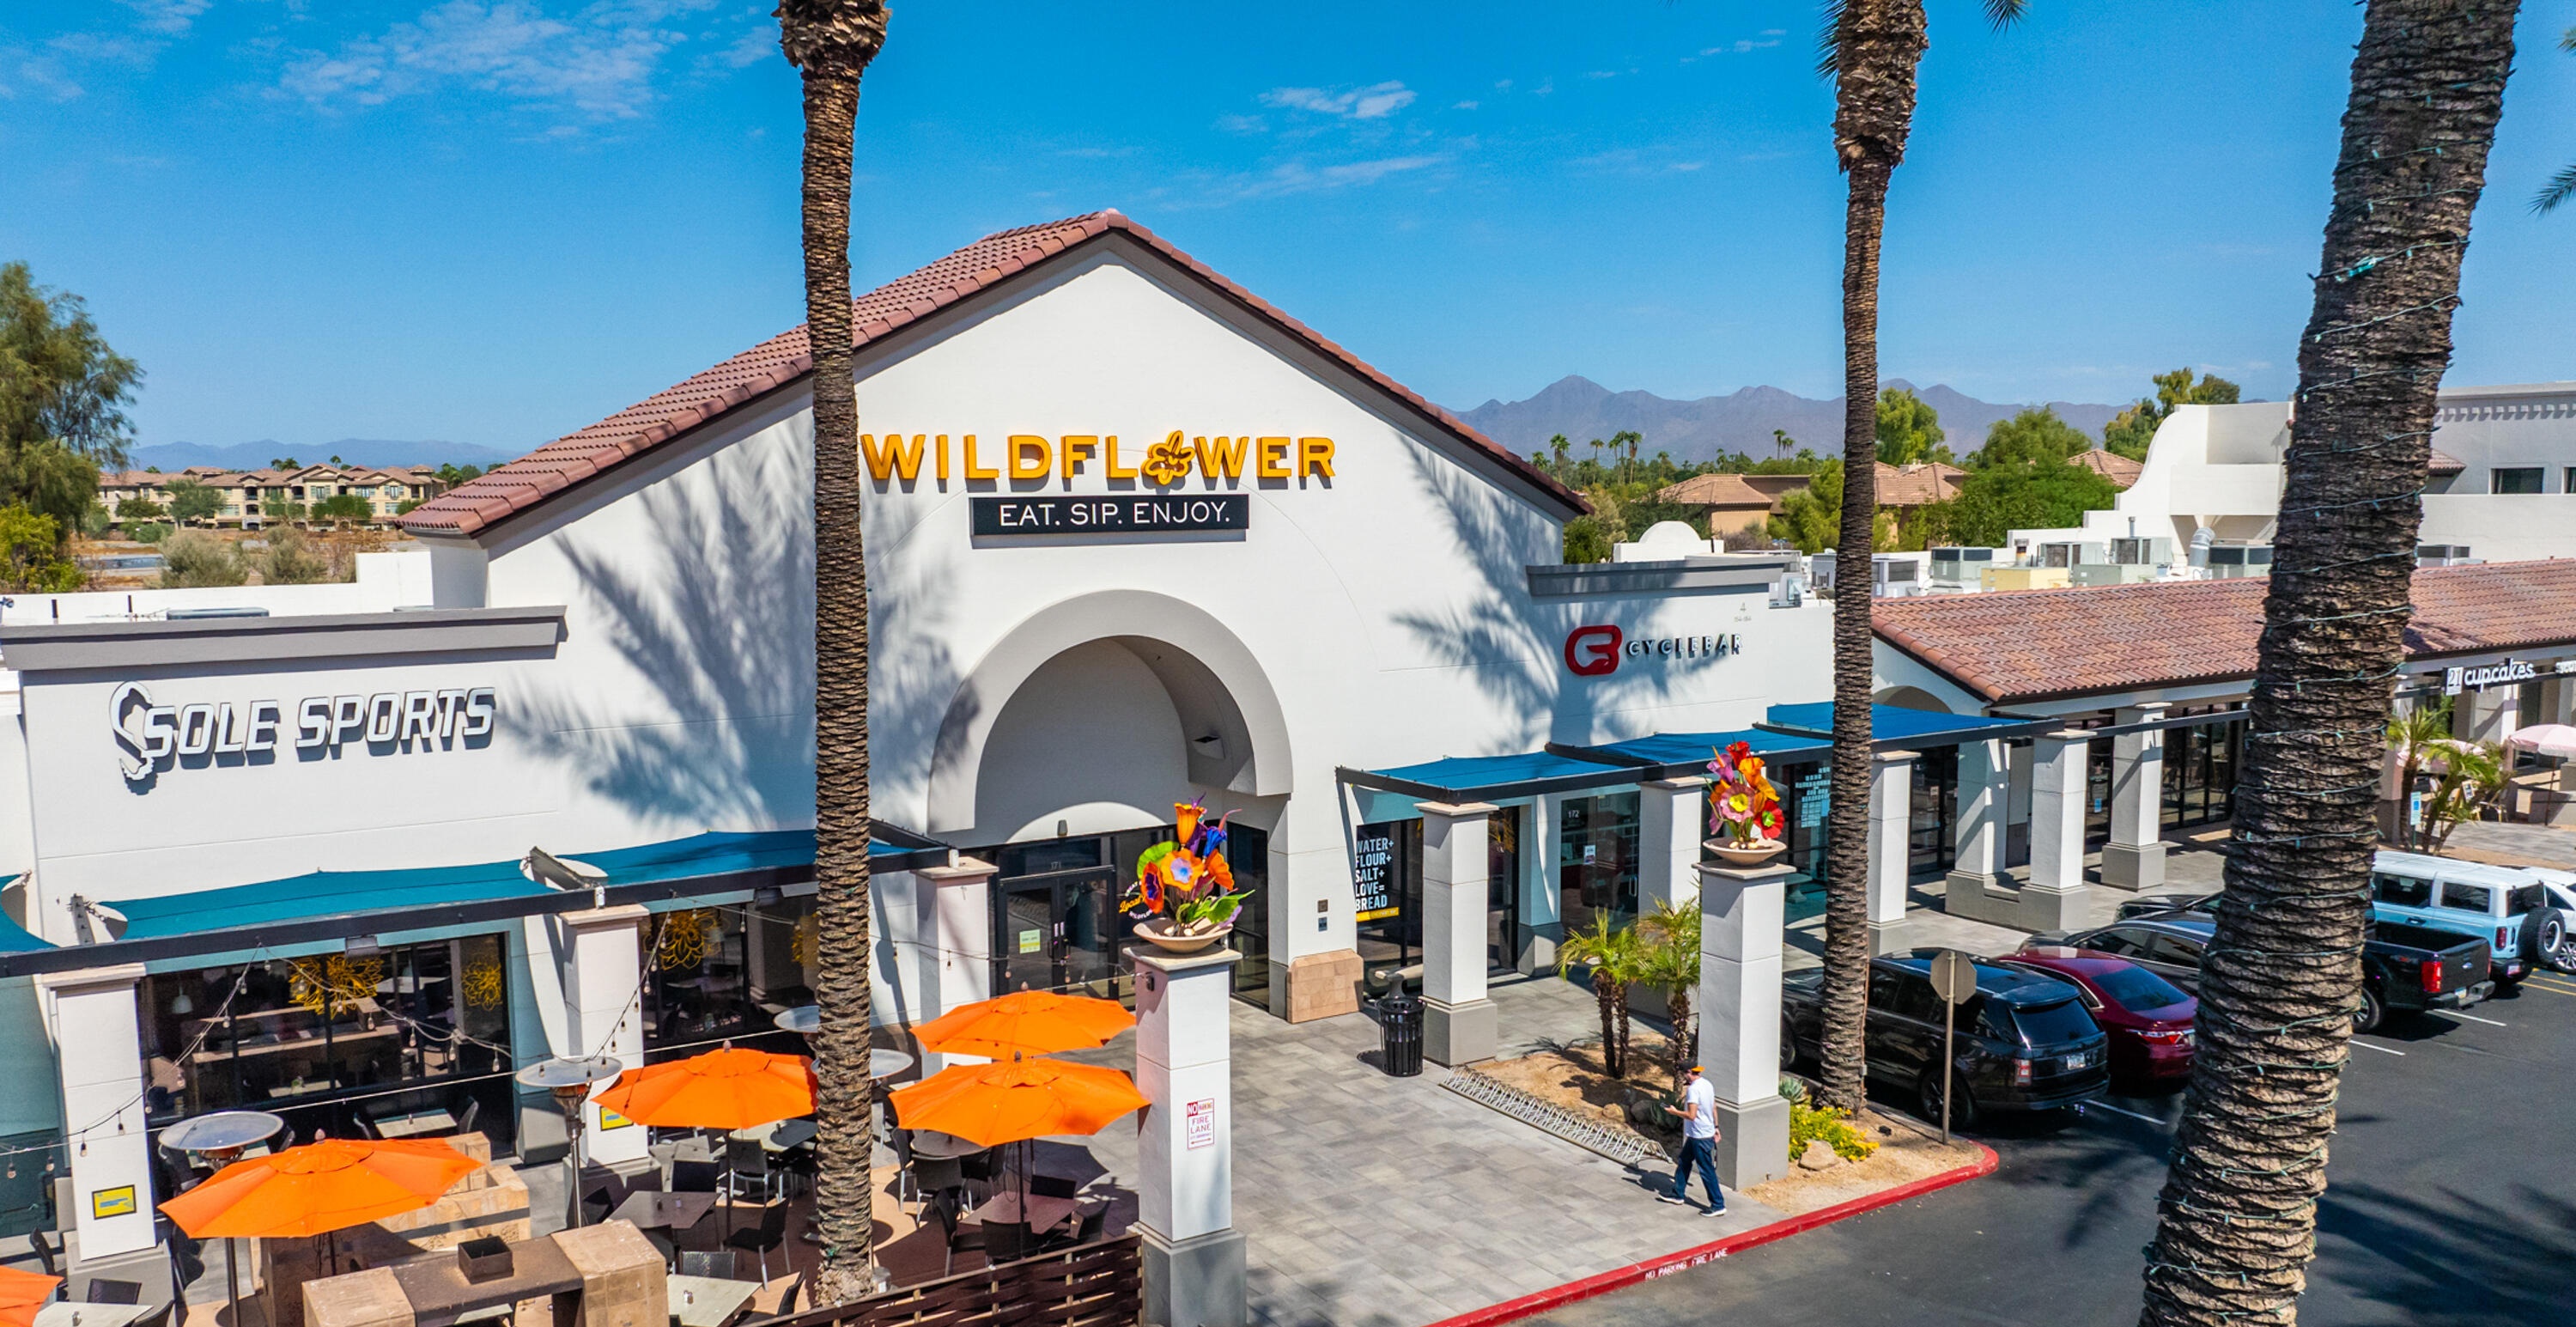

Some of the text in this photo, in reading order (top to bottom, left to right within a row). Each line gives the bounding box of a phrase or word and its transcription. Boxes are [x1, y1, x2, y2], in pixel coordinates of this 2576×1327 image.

[860, 430, 1335, 486] WILDFLOWER
[999, 499, 1230, 527] EAT. SIP. ENJOY.
[1625, 632, 1743, 657] CYCLEBAR
[2464, 657, 2537, 693] cupcakes
[143, 699, 279, 758] SOLE
[295, 687, 495, 748] SPORTS
[1188, 1103, 1198, 1116] NO
[1192, 1115, 1210, 1126] FIRE
[1190, 1123, 1212, 1135] LANE
[1644, 1247, 1728, 1280] NO PARKING FIRE LANE
